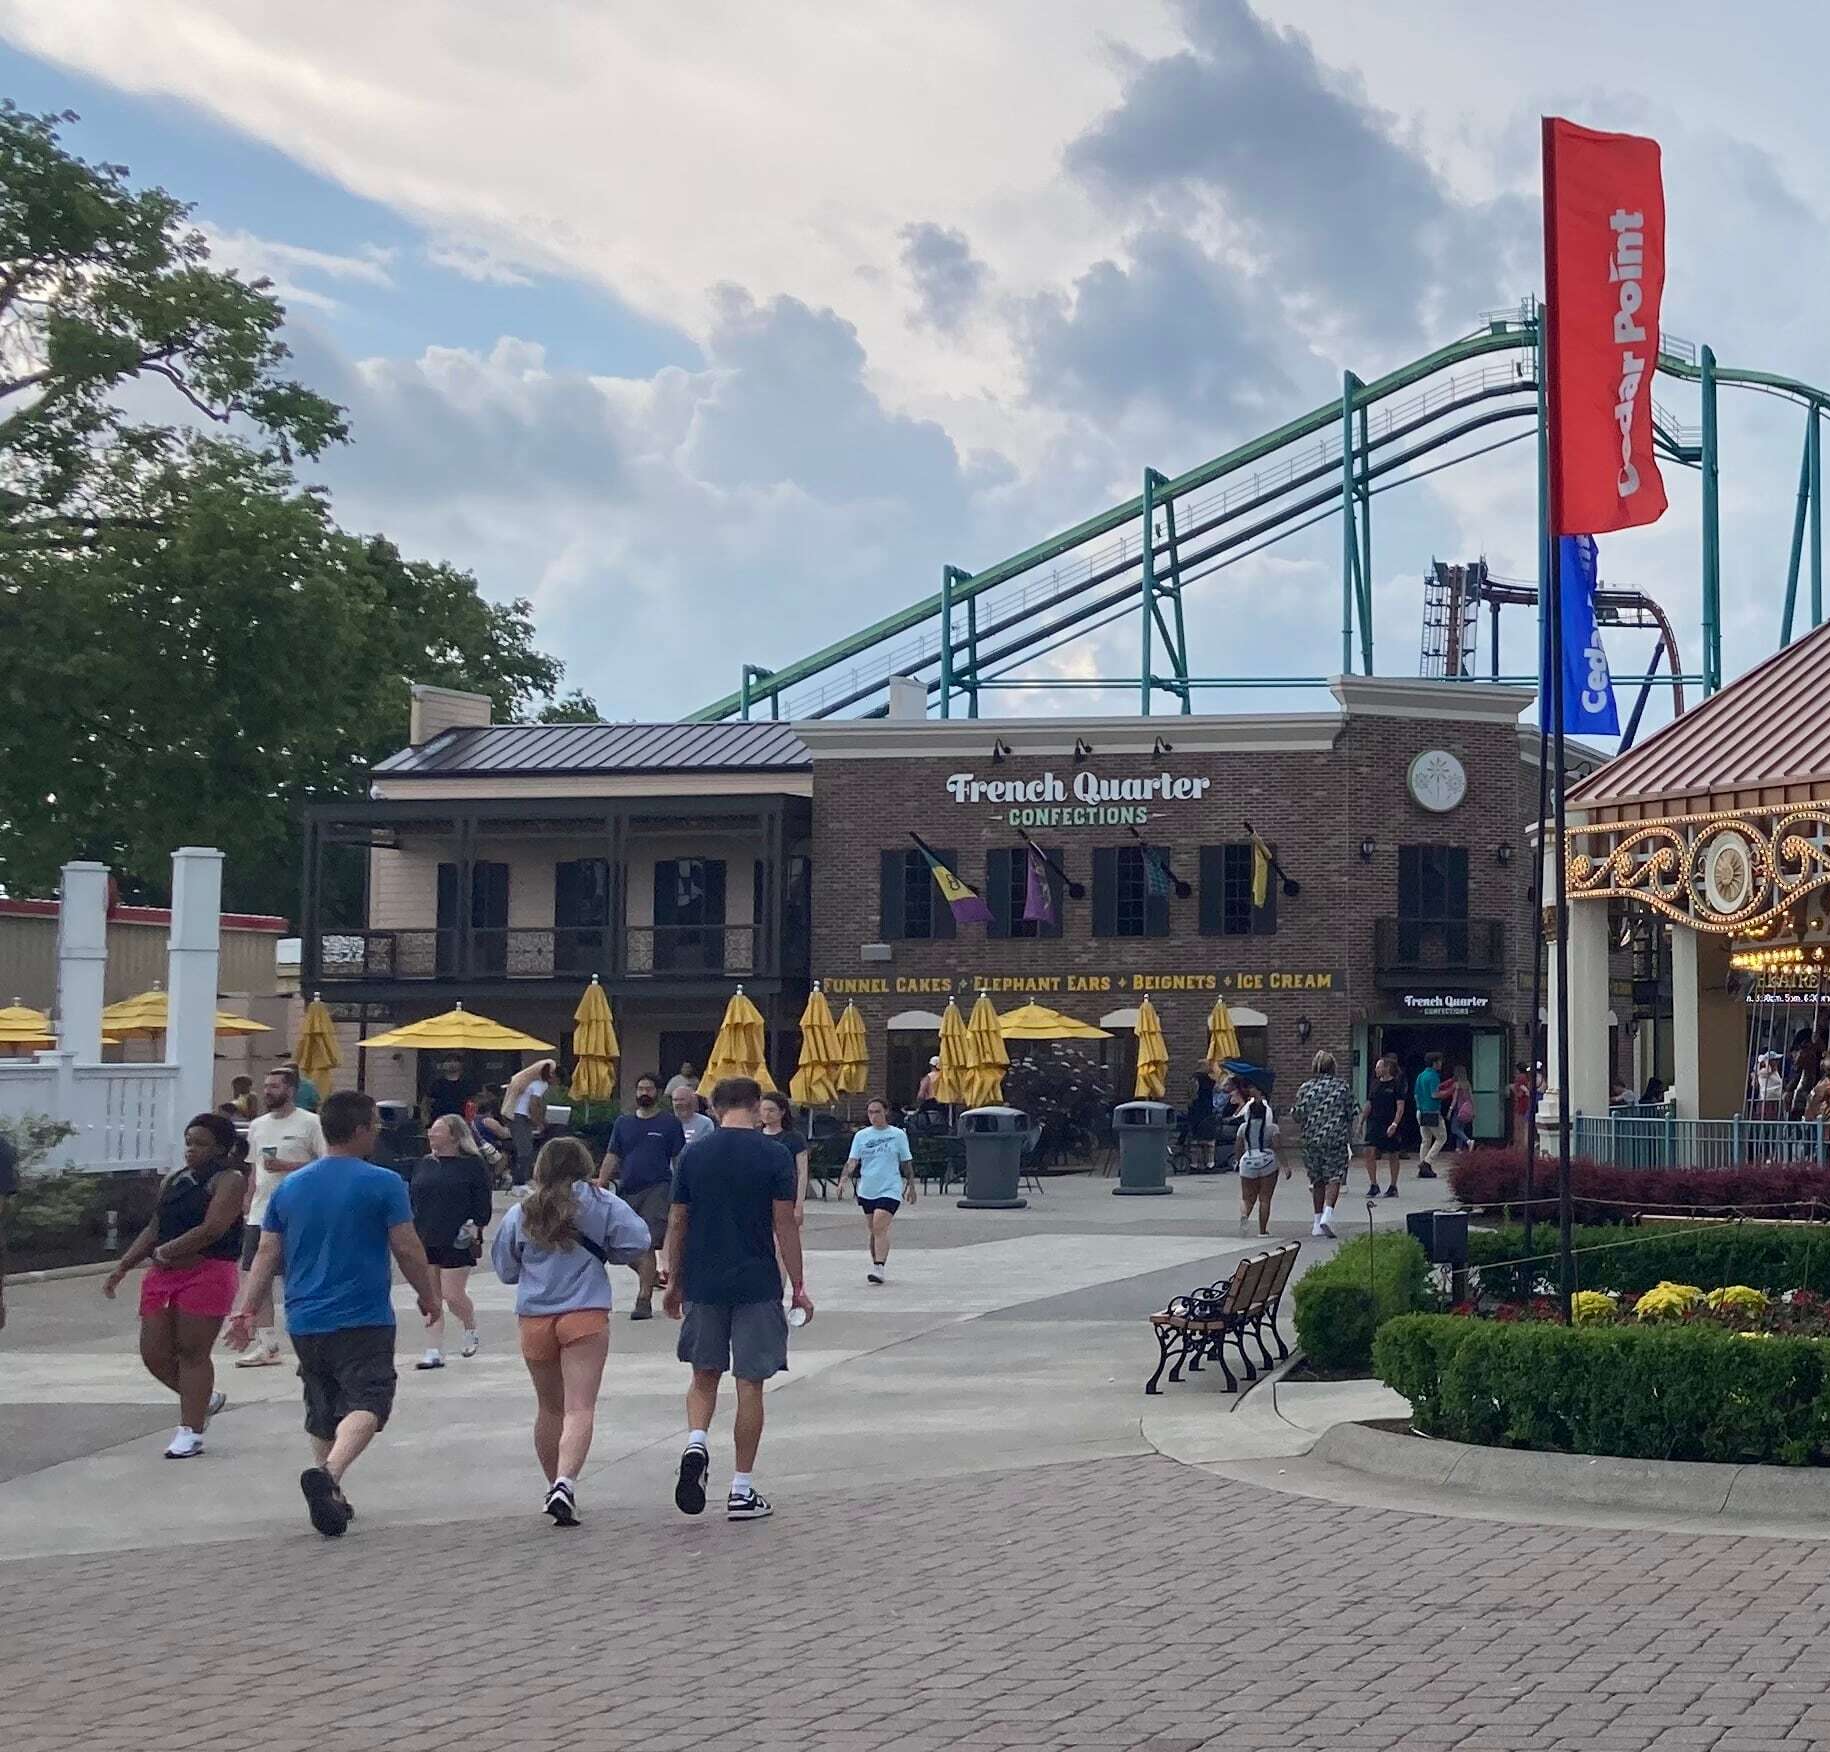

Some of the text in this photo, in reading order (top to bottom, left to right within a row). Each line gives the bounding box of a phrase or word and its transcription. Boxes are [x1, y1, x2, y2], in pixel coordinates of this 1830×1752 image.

[1608, 208, 1646, 497] Cedar Point
[946, 771, 1211, 806] French Quarter
[1008, 806, 1148, 826] CONFECTIONS
[823, 972, 1332, 993] FUNNEL CAKES ELEPHANT EARS BEIGNETS ICE CREAM
[1404, 995, 1489, 1007] French Quarter
